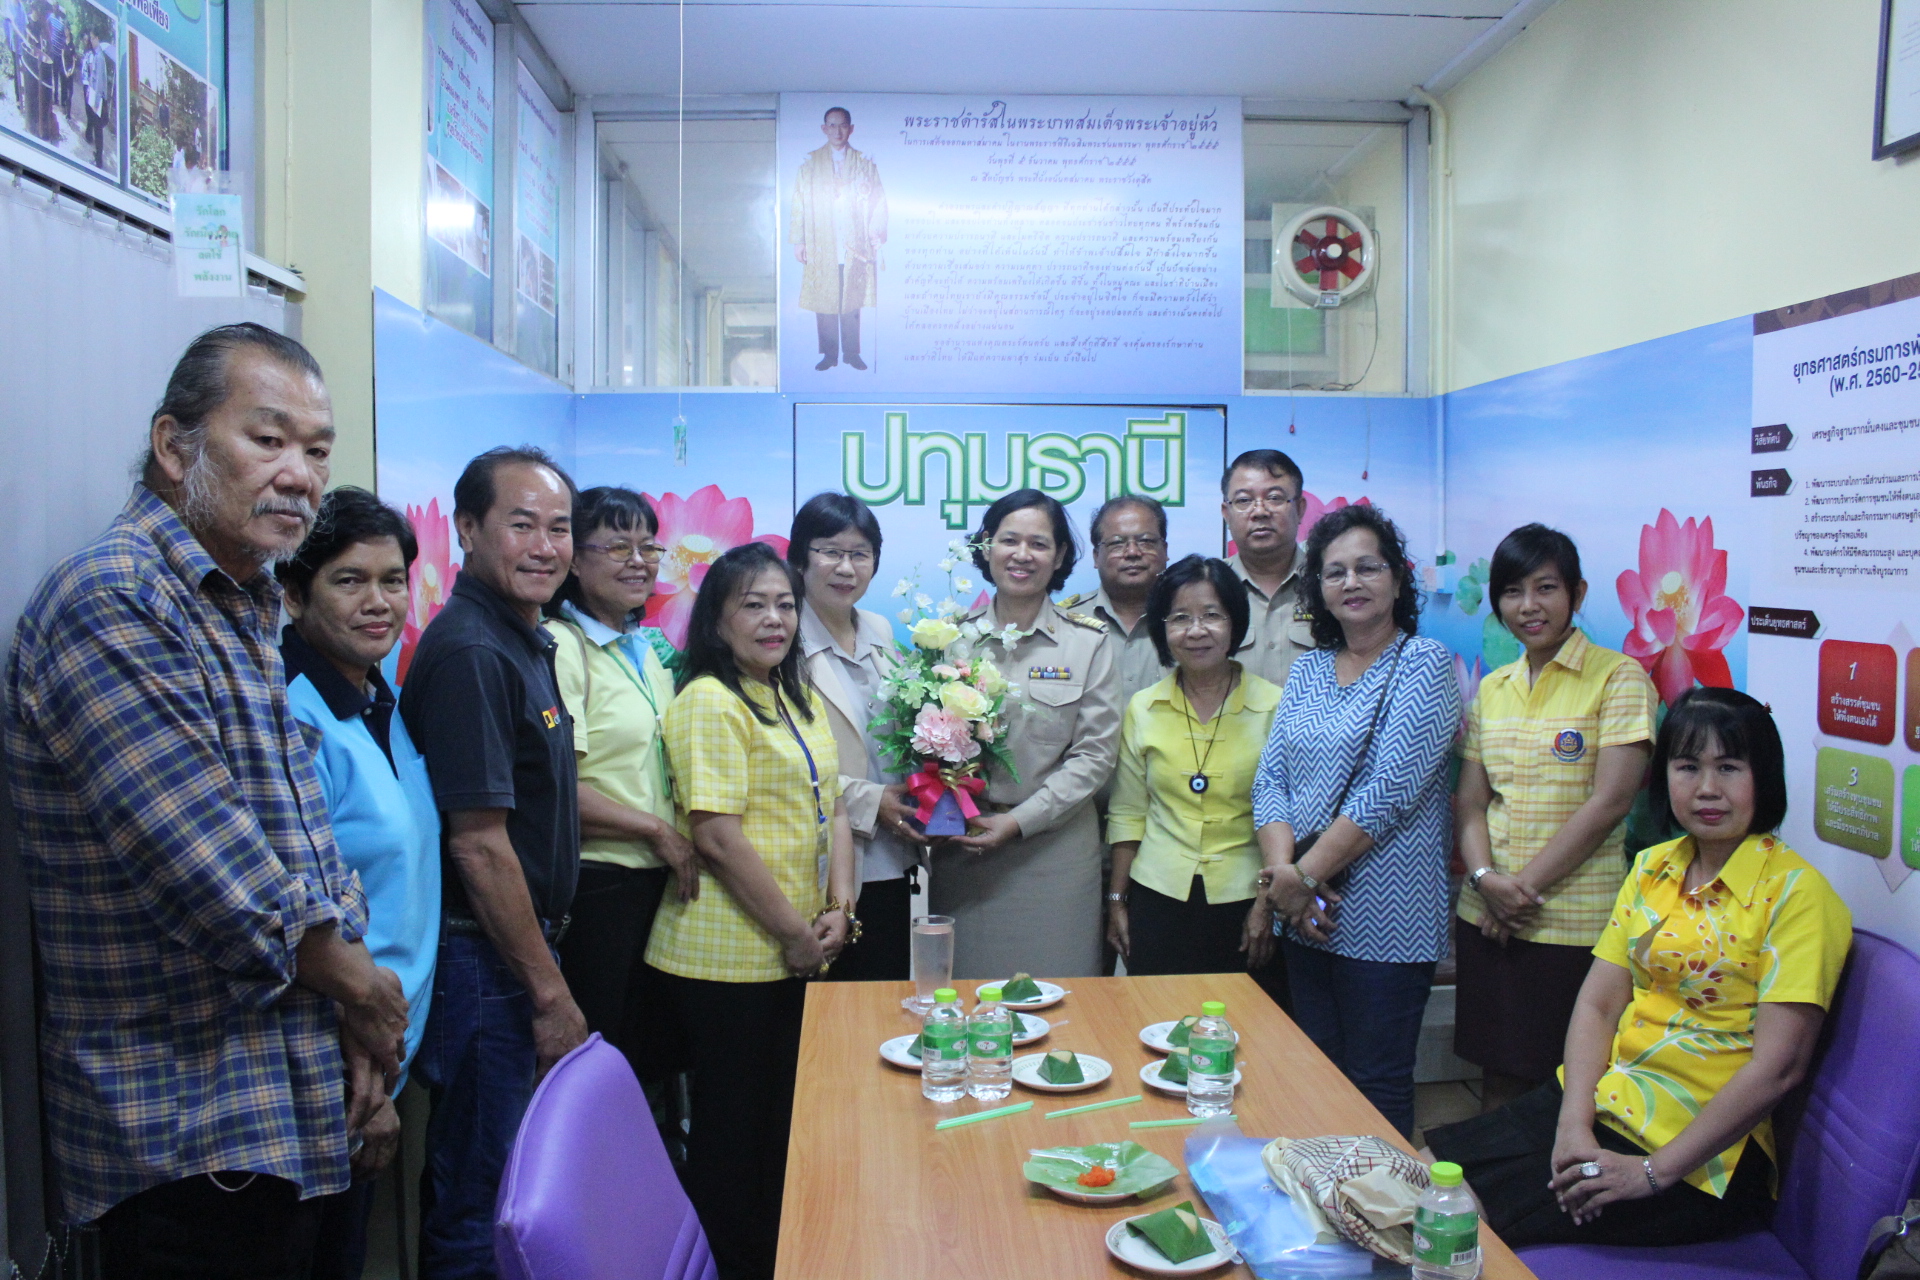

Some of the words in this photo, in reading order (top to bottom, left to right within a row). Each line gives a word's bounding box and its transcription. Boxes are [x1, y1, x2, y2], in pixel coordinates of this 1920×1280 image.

[904, 100, 1218, 140] พระราชดำรัสในพระบาทสมเด็จพระเจ้าอยู่หัว
[1829, 373, 1862, 398] (พ.ศ.
[1866, 361, 1920, 388] 2560-2
[841, 411, 1187, 530] ปทุมธานี
[1755, 476, 1778, 489] พันธกิจ
[1848, 661, 1858, 680] 1
[1848, 767, 1858, 786] 3
